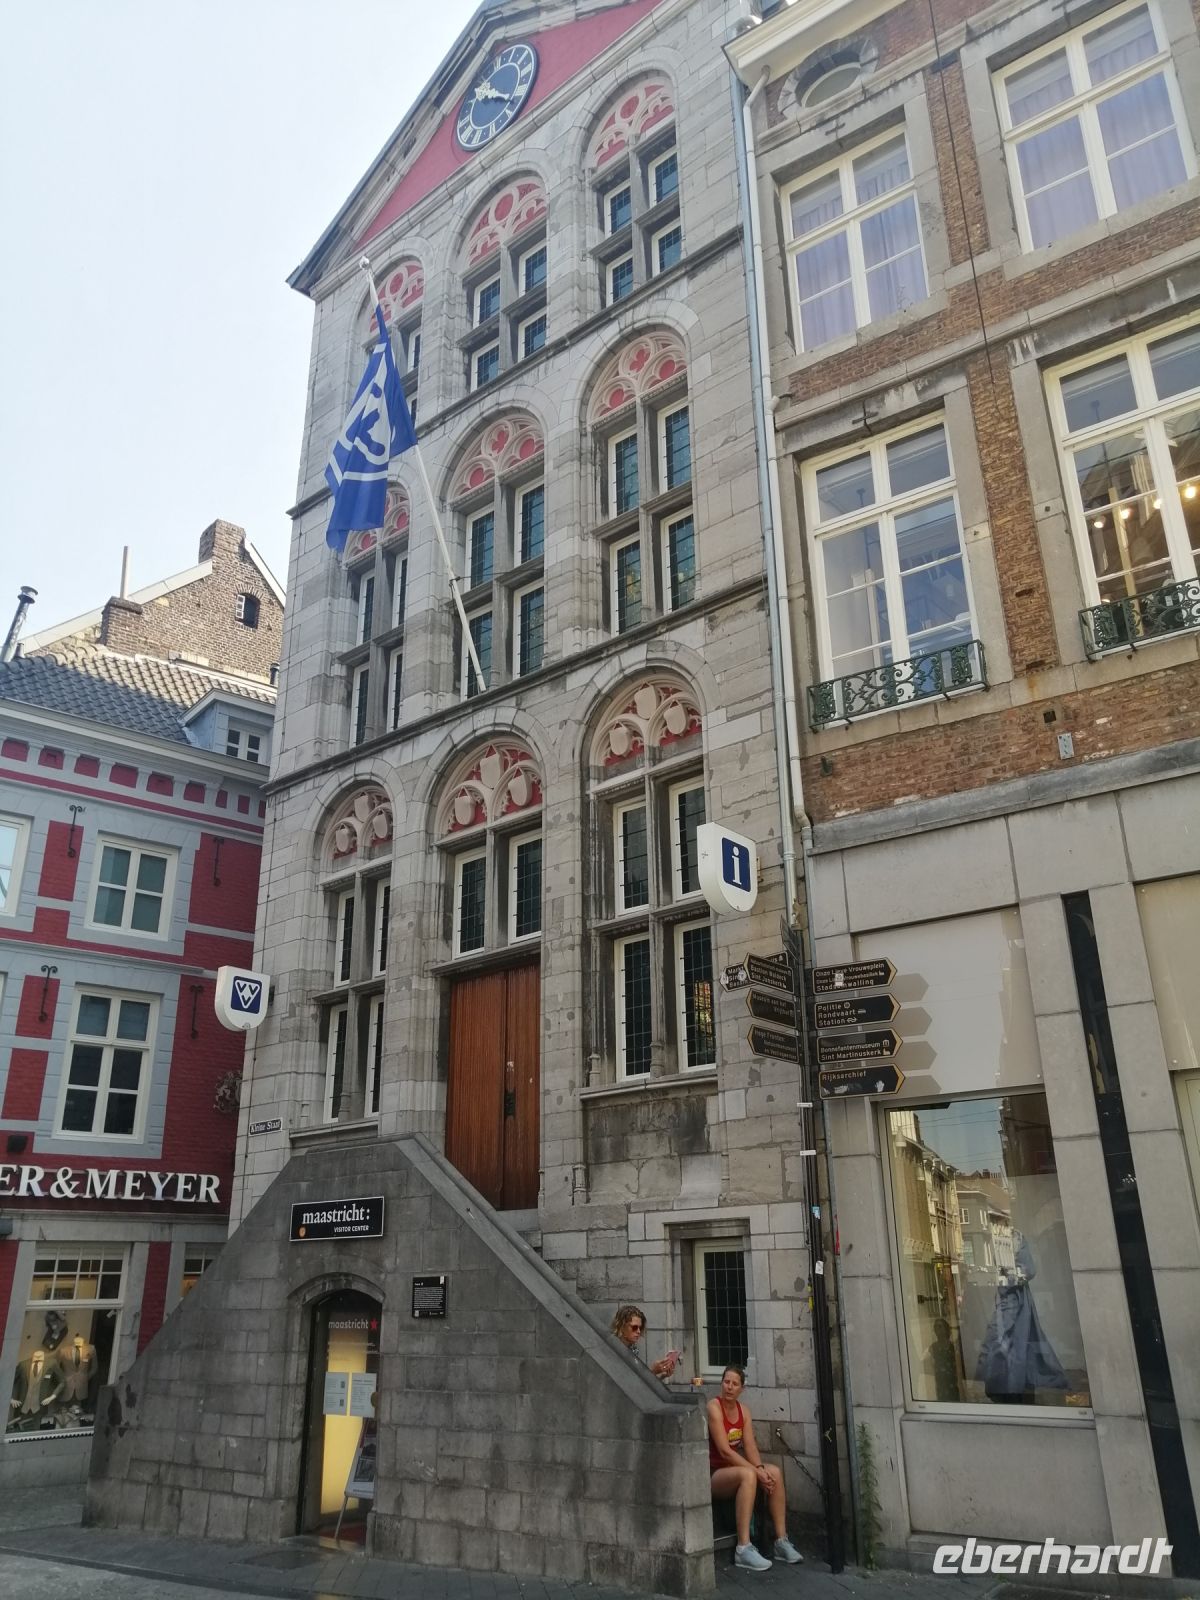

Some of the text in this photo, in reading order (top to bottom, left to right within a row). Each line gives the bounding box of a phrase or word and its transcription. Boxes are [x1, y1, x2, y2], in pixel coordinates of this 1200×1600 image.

[817, 1003, 842, 1012] Politie
[818, 1009, 856, 1019] Rondvaart
[818, 1018, 846, 1027] Station
[821, 1049, 882, 1061] Sint Martinuskerk
[822, 1070, 867, 1081] Rijksarchief
[333, 1224, 369, 1233] VISITOR CENTER
[328, 1318, 369, 1329] maastricht
